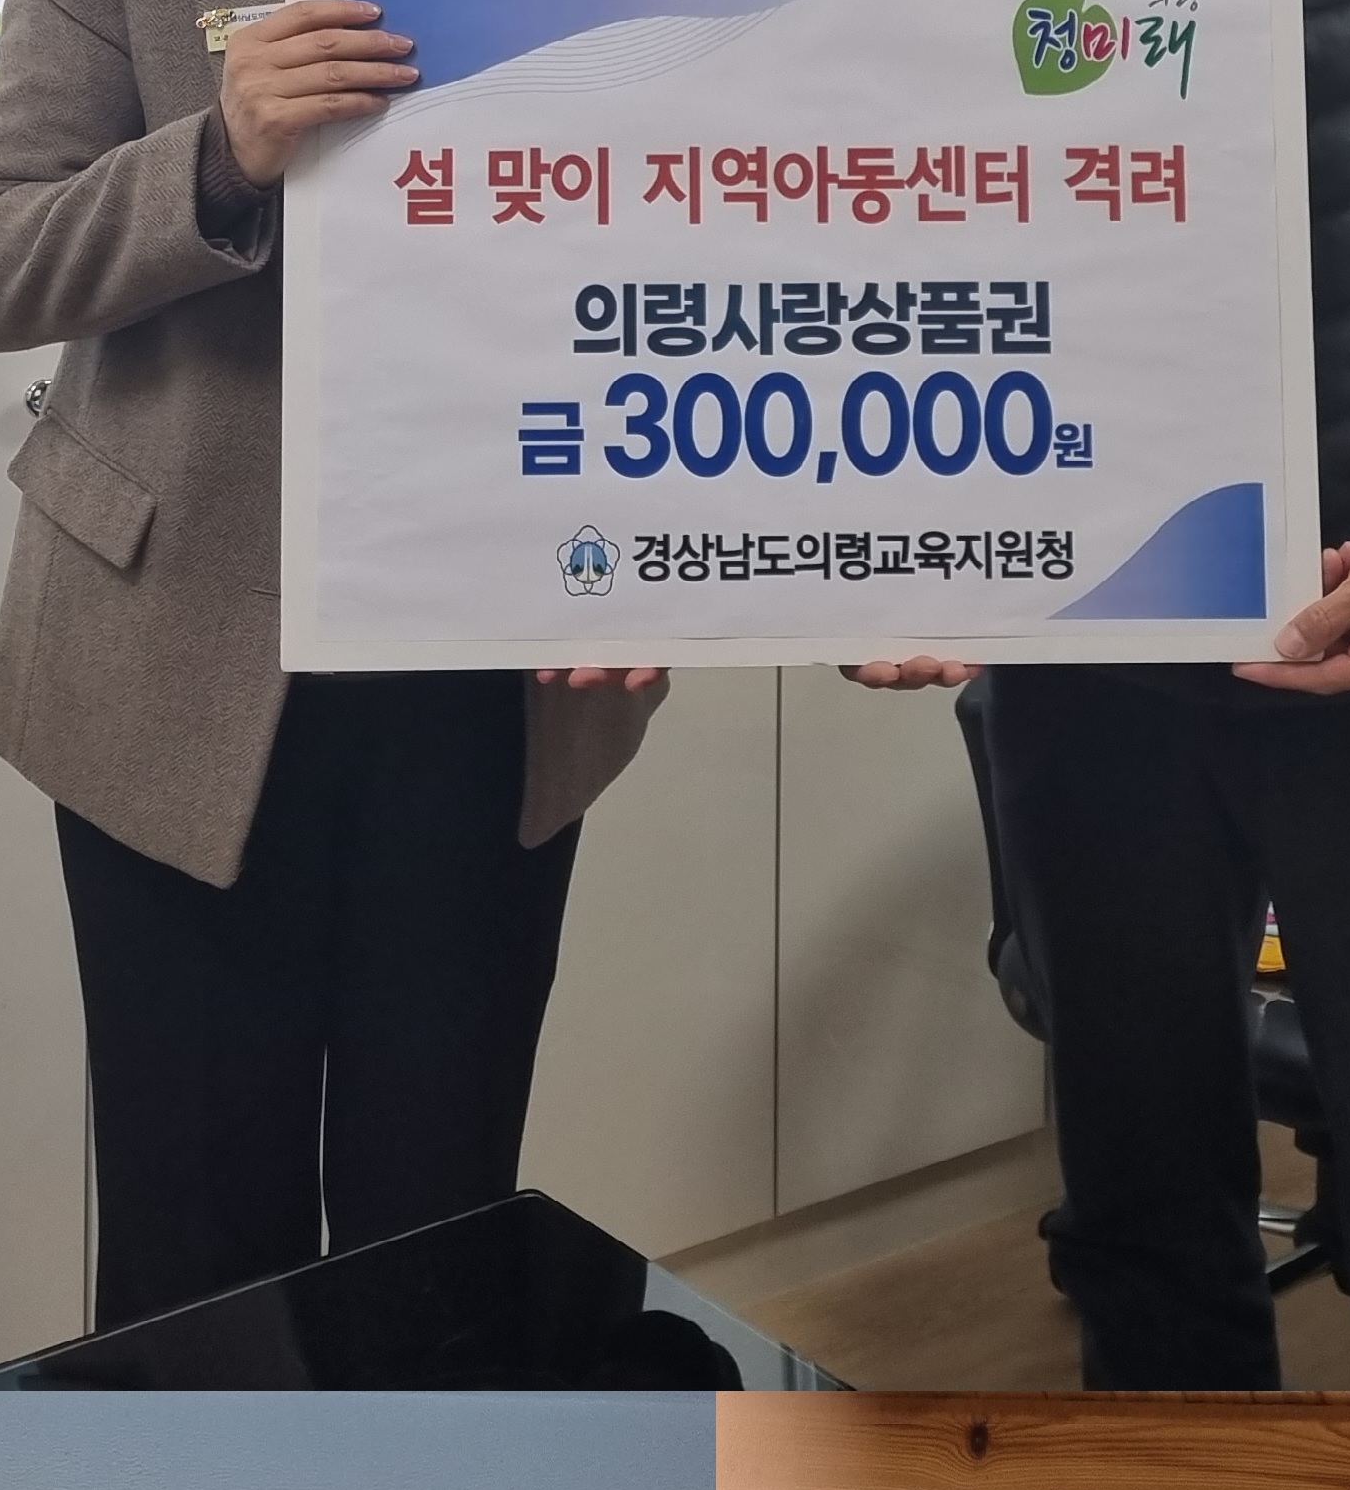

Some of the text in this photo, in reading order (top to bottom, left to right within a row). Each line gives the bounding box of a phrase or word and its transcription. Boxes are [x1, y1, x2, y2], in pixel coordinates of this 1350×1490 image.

[1024, 8, 1199, 101] 청미래
[393, 144, 1188, 227] 설 맞이 지역아동센터 격려
[573, 280, 1052, 357] 의령사랑상품권
[518, 370, 1094, 485] 금 300,000원
[631, 528, 1075, 583] 경상남도의령교육지원청
